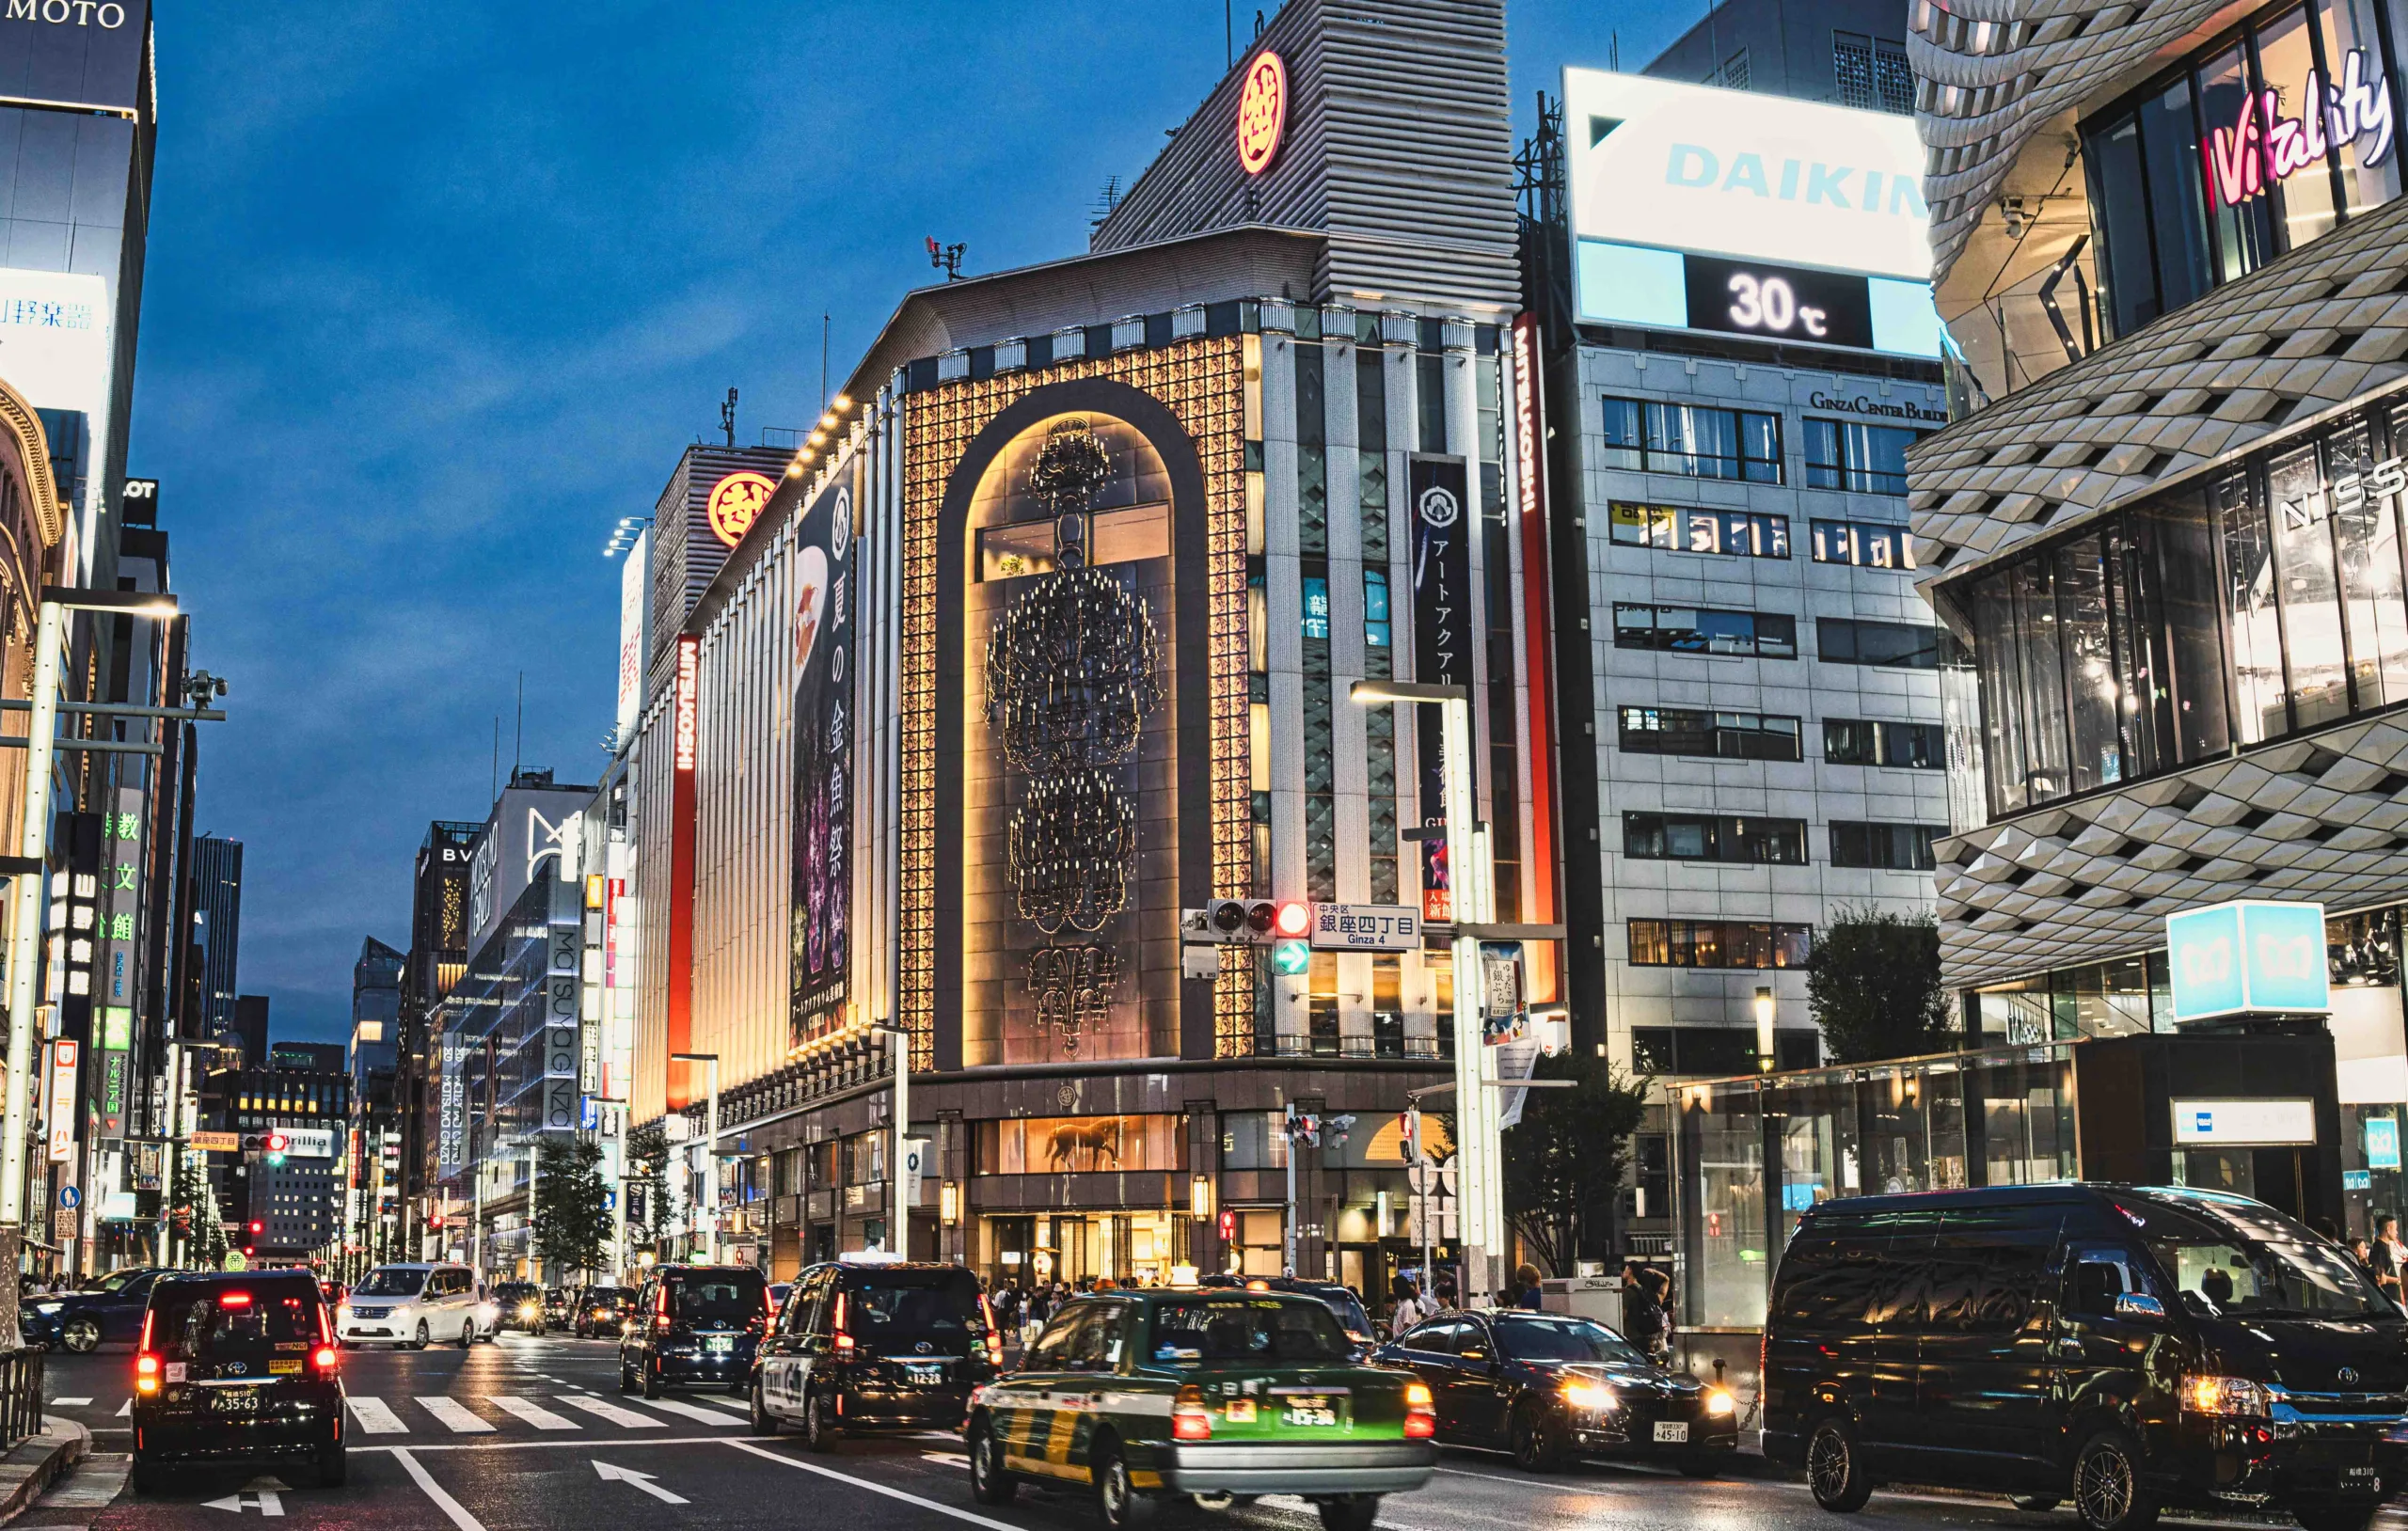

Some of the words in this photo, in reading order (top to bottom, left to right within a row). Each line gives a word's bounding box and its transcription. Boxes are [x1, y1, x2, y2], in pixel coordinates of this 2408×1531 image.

[6, 0, 125, 28] MOTO
[2213, 48, 2393, 207] Vitality
[1515, 326, 1535, 513] MITSUKOSHI
[123, 481, 155, 497] OT
[677, 641, 696, 769] MITSUKOSHI
[829, 571, 847, 878] 夏の金魚祭
[112, 813, 139, 940] 教文館
[1319, 905, 1349, 914] 中央区
[1319, 914, 1413, 935] 銀座四丁目
[1348, 934, 1374, 944] Ginza
[1378, 935, 1386, 944] 4
[106, 1056, 120, 1113] ナルニア国
[194, 1136, 235, 1145] 銀座四丁目
[226, 1397, 259, 1411] 35-63
[1661, 1429, 1687, 1441] 45-10
